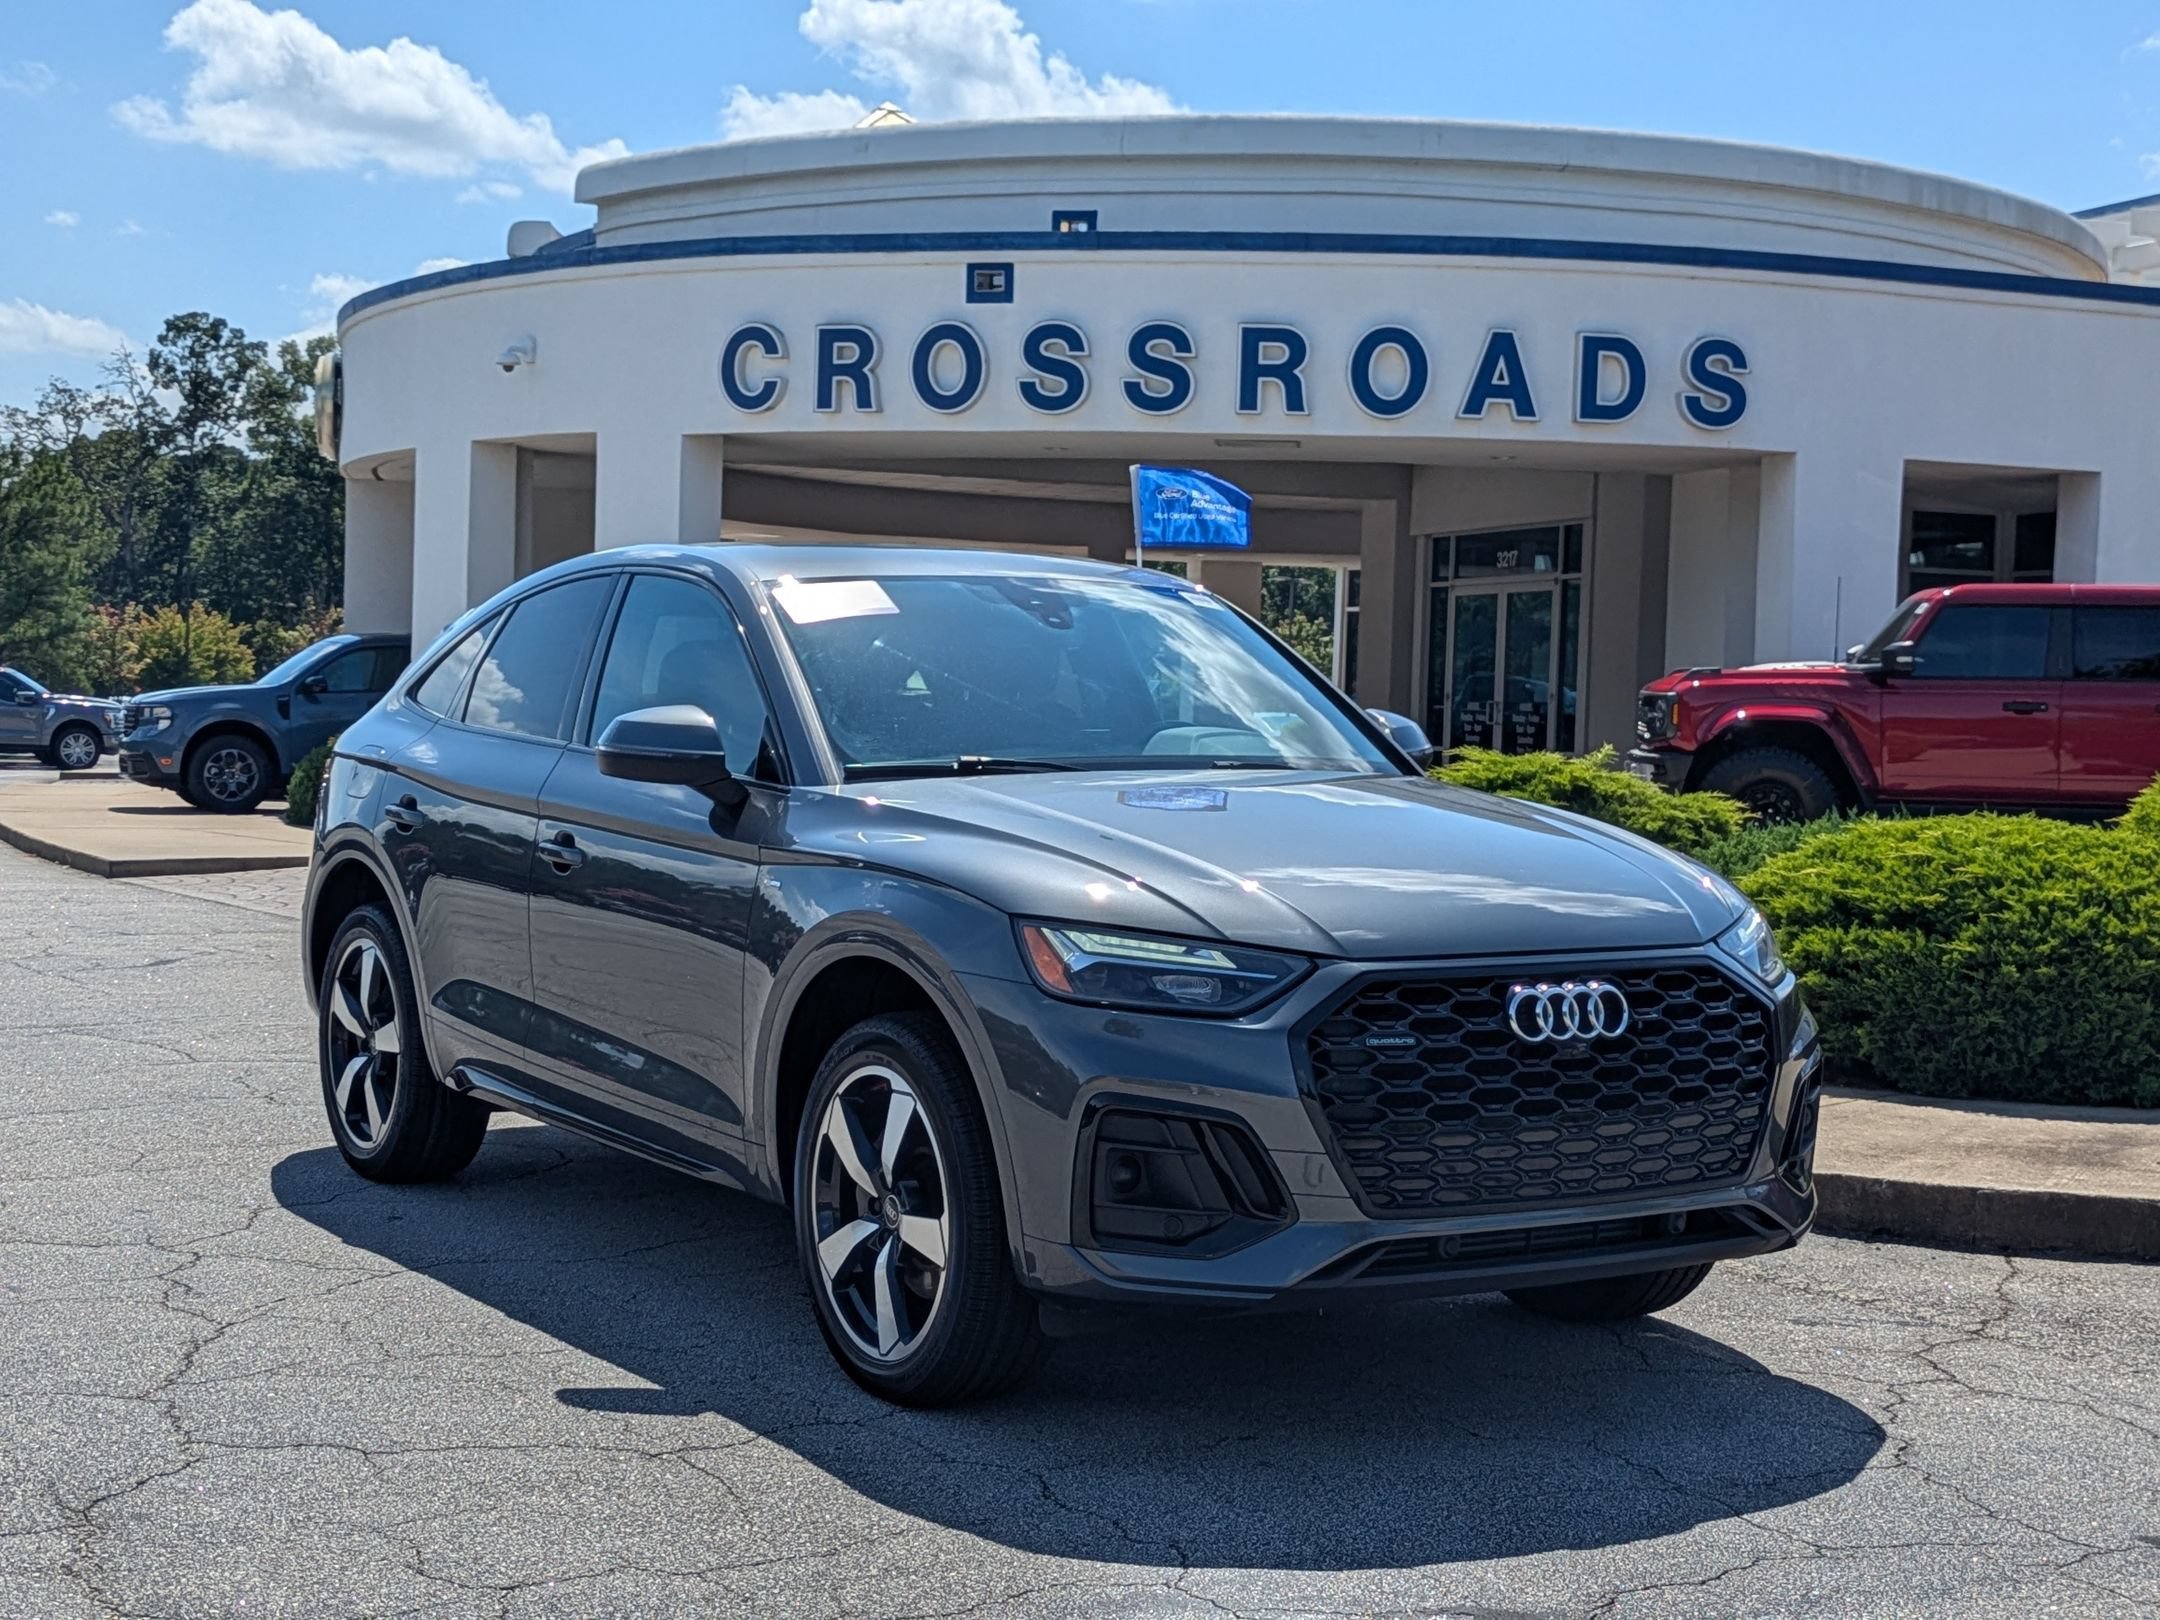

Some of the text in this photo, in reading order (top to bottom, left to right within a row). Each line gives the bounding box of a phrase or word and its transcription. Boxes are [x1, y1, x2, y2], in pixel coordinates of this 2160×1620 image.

[719, 320, 1750, 431] CROSSROADS
[1496, 550, 1518, 568] 3217
[1367, 1037, 1415, 1046] quattro
